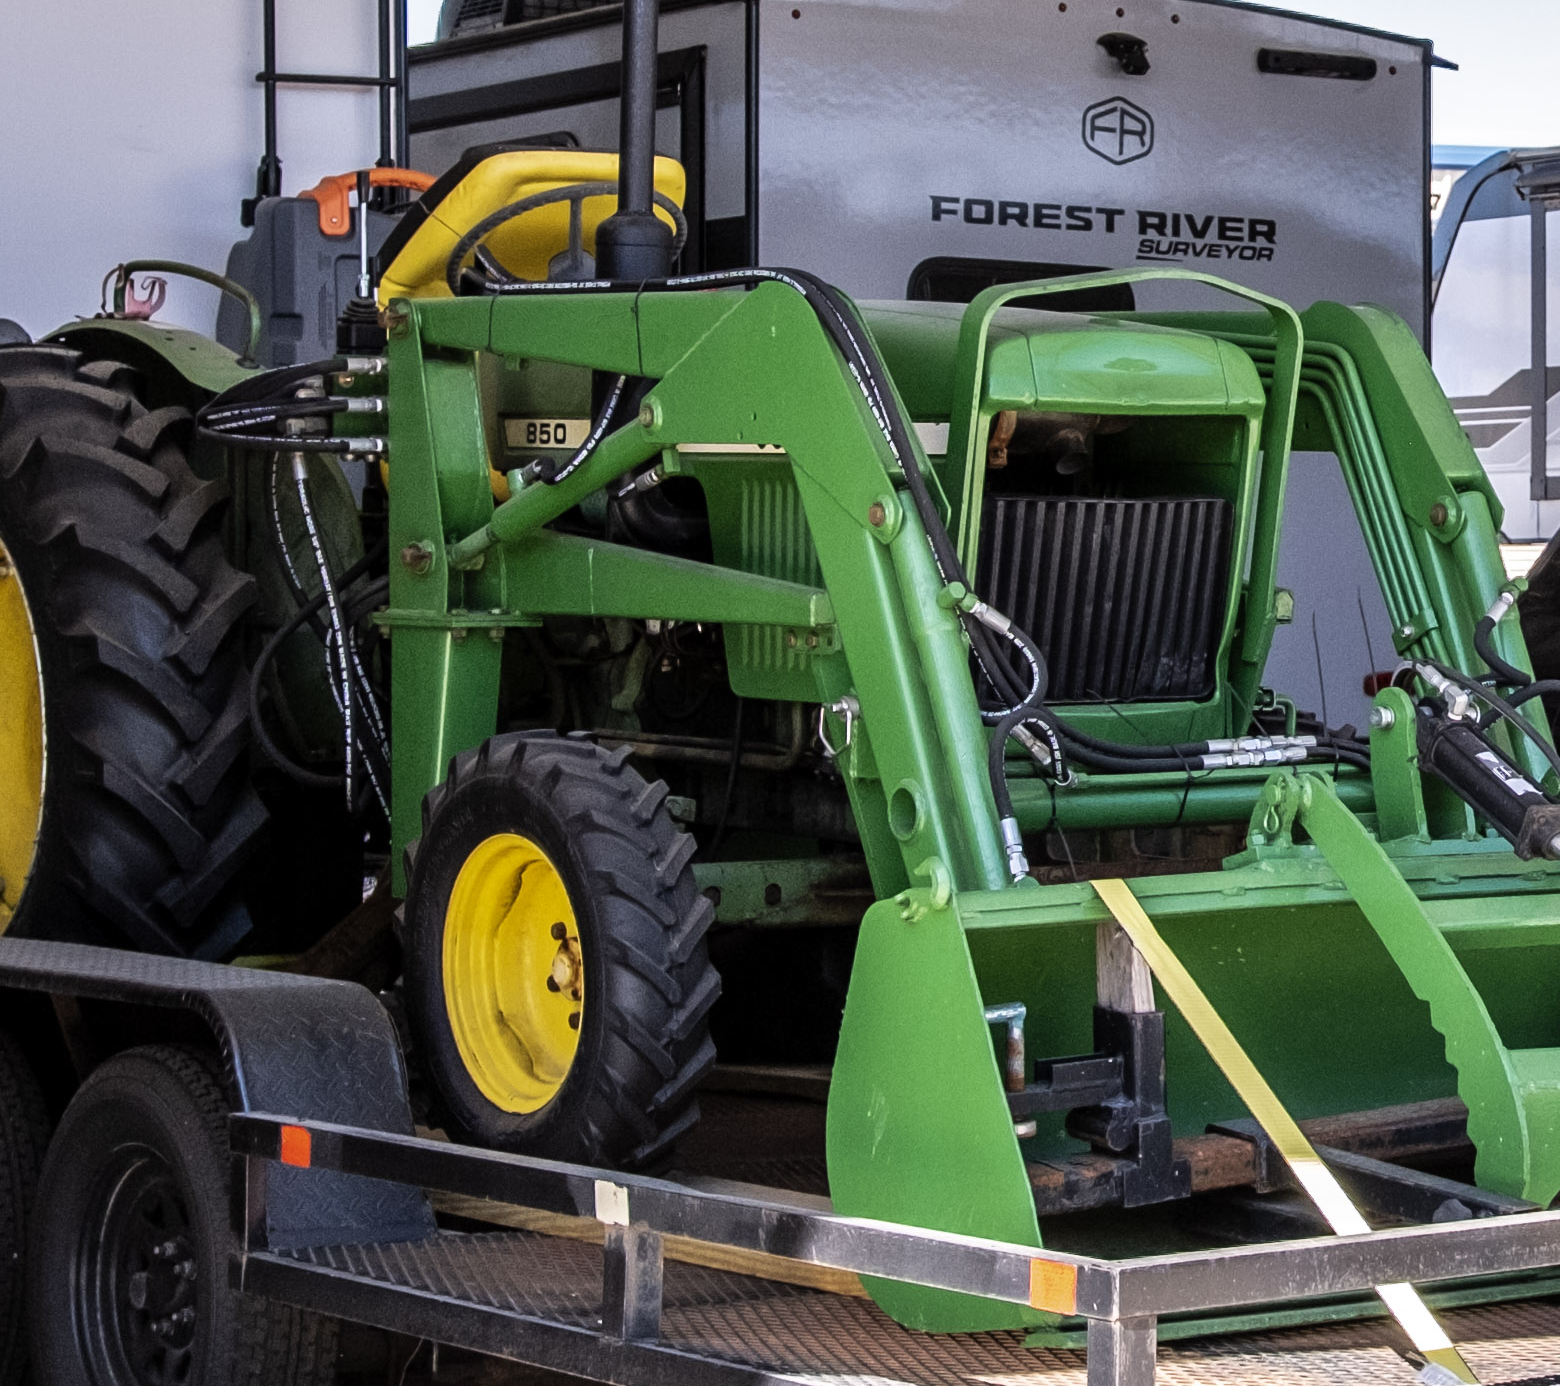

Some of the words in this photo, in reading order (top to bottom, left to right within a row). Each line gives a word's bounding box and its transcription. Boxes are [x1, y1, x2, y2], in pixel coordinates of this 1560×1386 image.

[1089, 105, 1147, 156] FR
[929, 195, 1125, 233] FOREST
[1137, 210, 1277, 245] RIVER
[1137, 238, 1274, 263] SURVEYOR
[526, 423, 567, 445] 850
